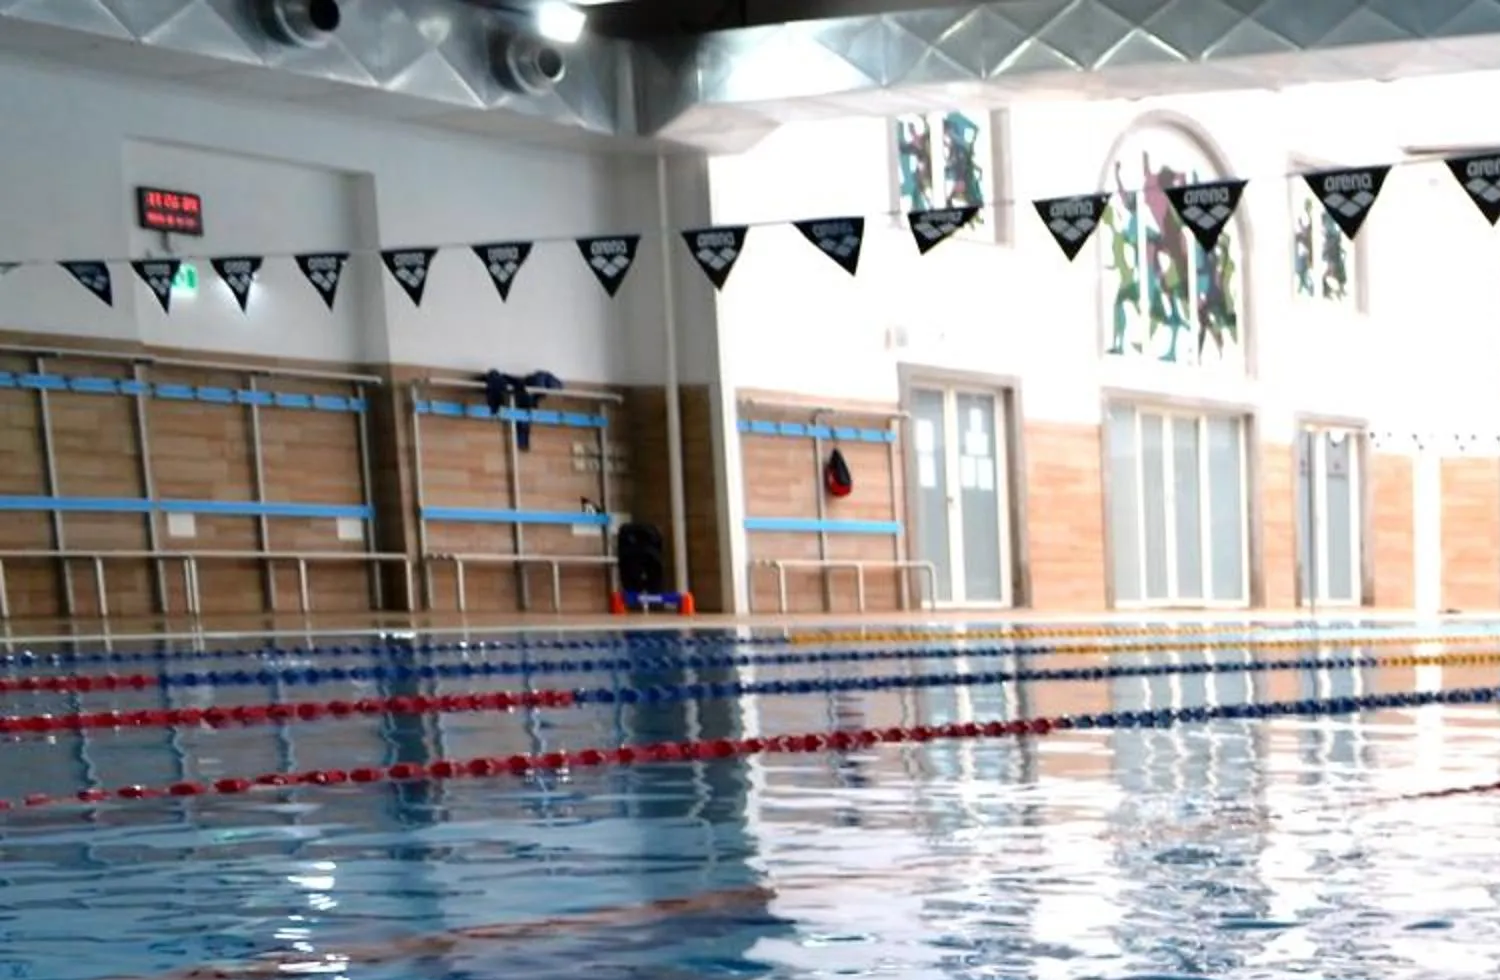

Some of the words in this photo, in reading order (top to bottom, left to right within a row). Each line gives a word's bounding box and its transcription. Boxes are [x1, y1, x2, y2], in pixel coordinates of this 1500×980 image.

[1323, 172, 1373, 193] arena
[1183, 187, 1229, 205] arena
[1050, 200, 1094, 217] arena
